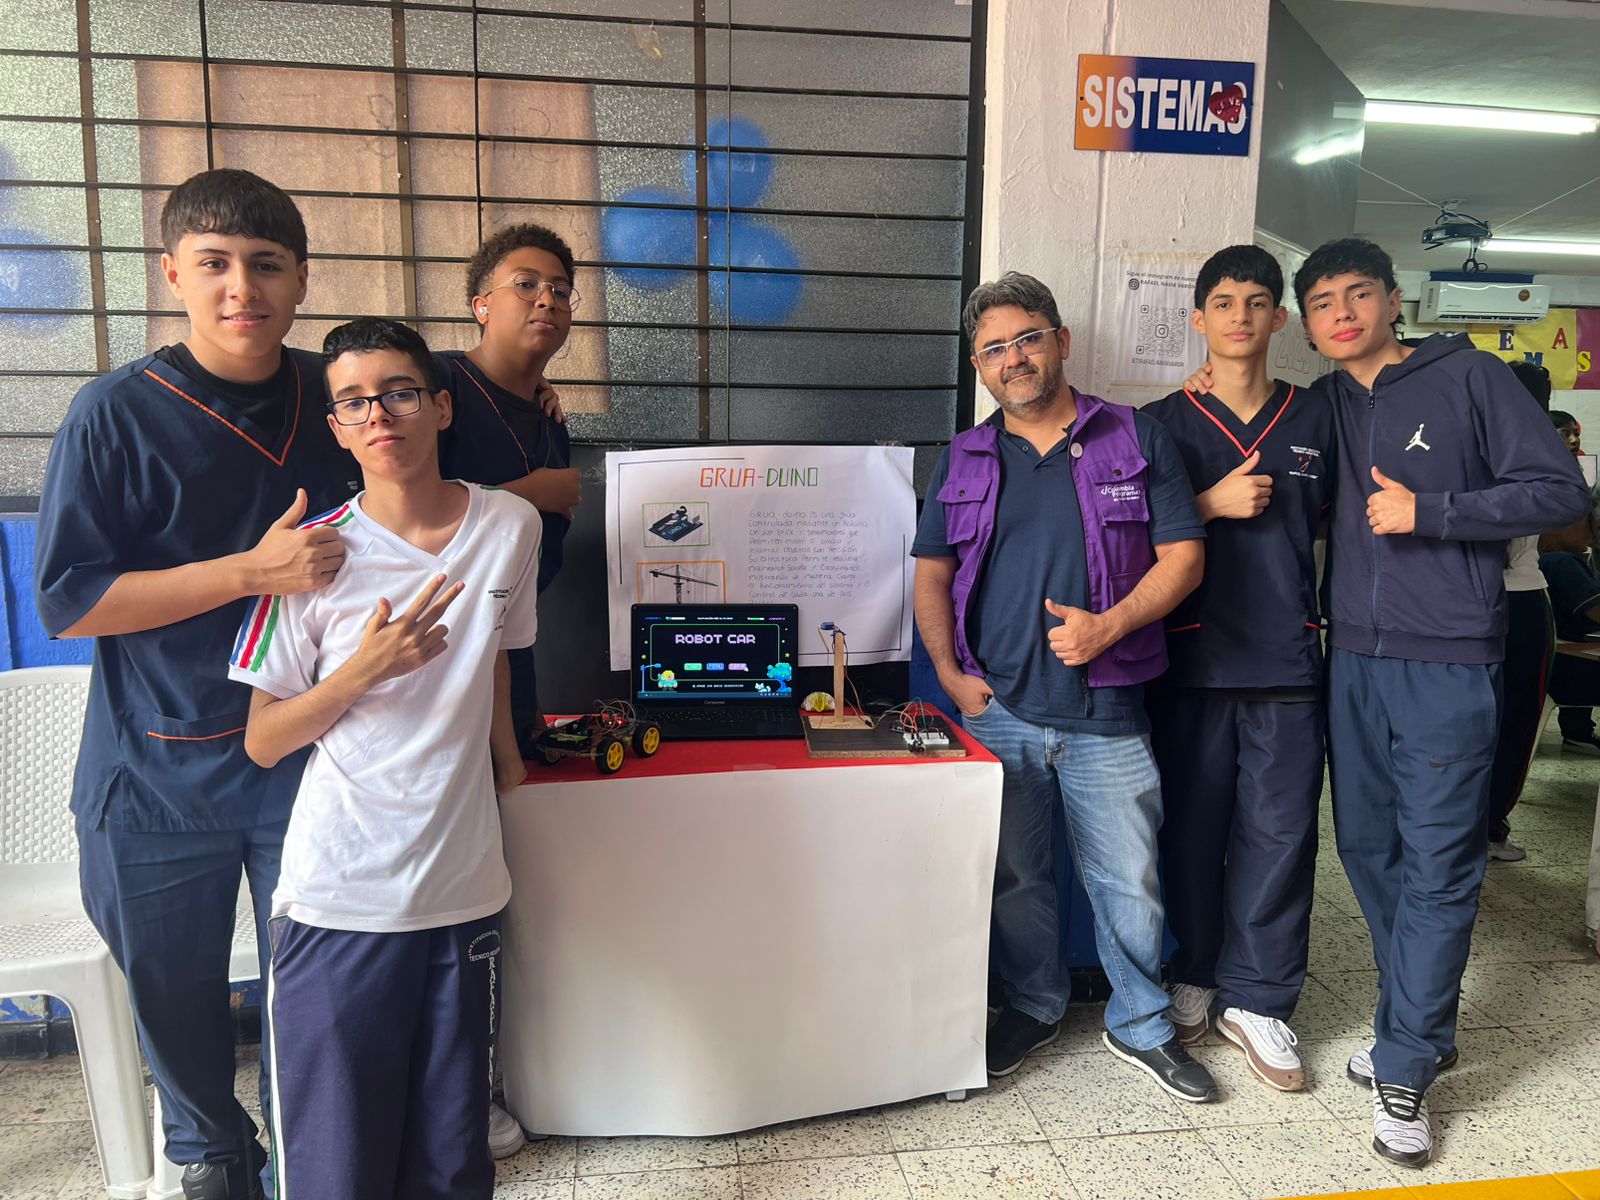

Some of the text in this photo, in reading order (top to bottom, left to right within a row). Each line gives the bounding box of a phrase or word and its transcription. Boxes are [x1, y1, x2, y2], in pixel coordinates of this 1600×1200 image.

[1083, 74, 1247, 135] SISTEMAS
[675, 634, 756, 644] ROBOT CAR
